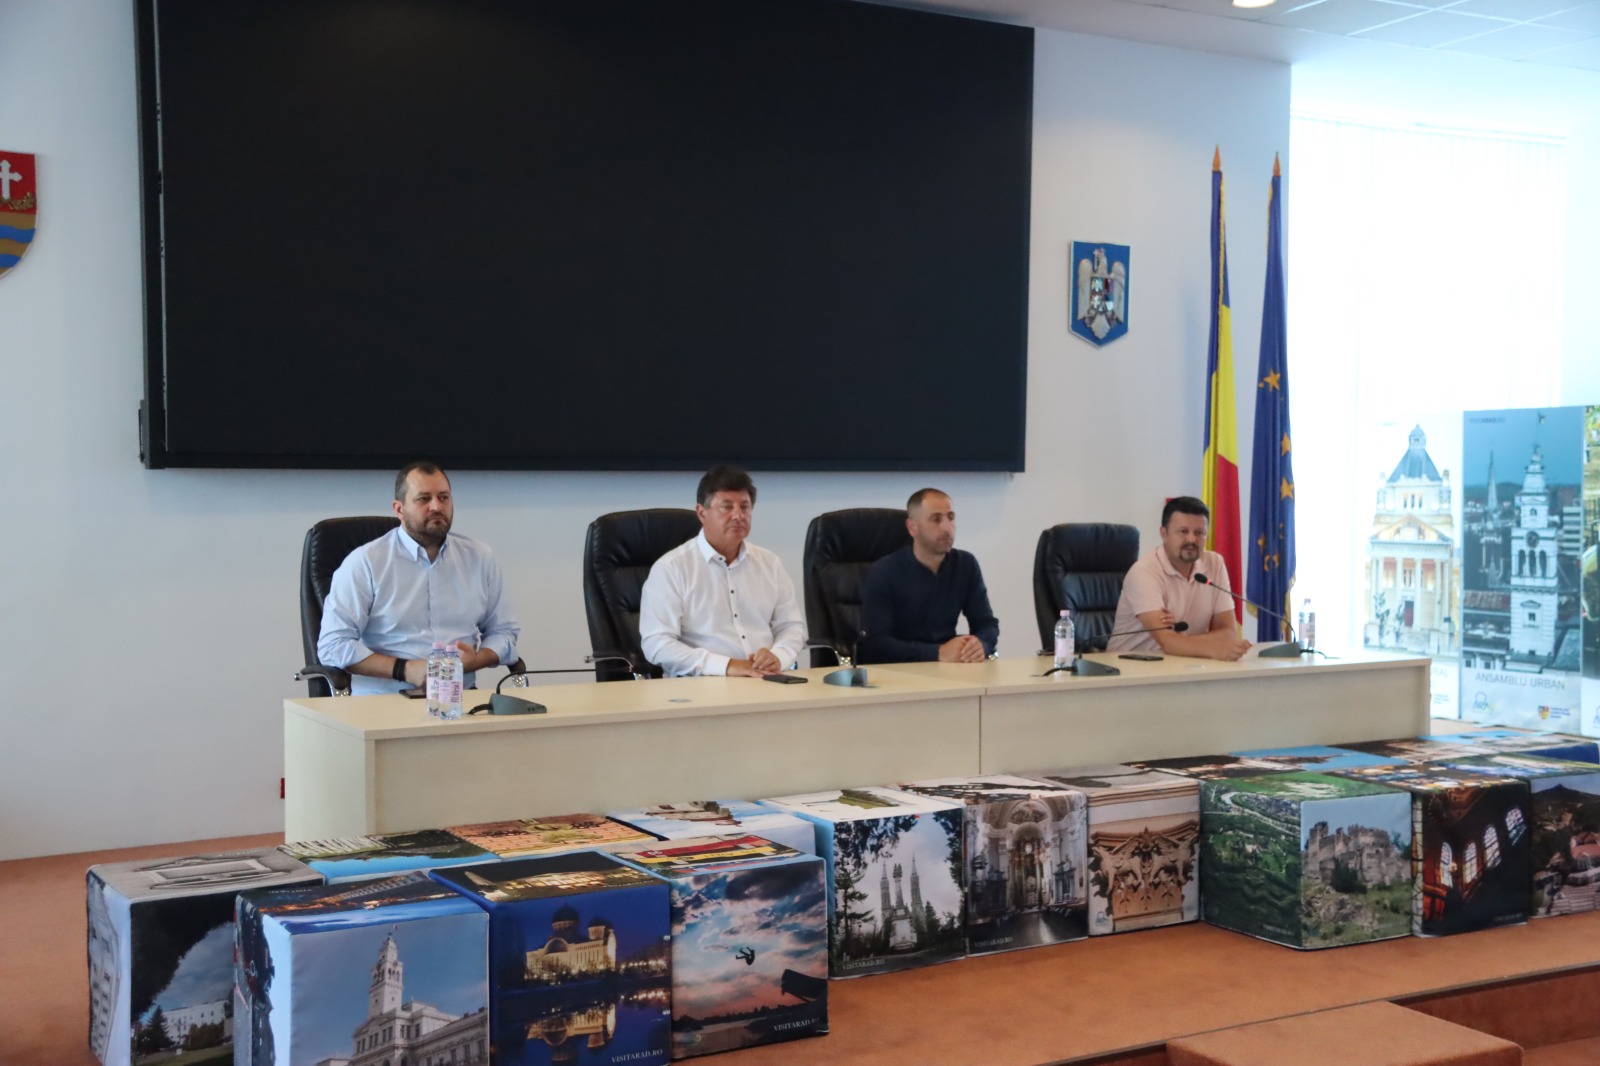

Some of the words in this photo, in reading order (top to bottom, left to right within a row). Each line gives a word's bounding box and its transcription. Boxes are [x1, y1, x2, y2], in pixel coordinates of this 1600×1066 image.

[1475, 672, 1527, 686] ANSAMBLU
[1530, 678, 1565, 690] URBAN
[611, 1048, 663, 1063] VISITARAD.RO
